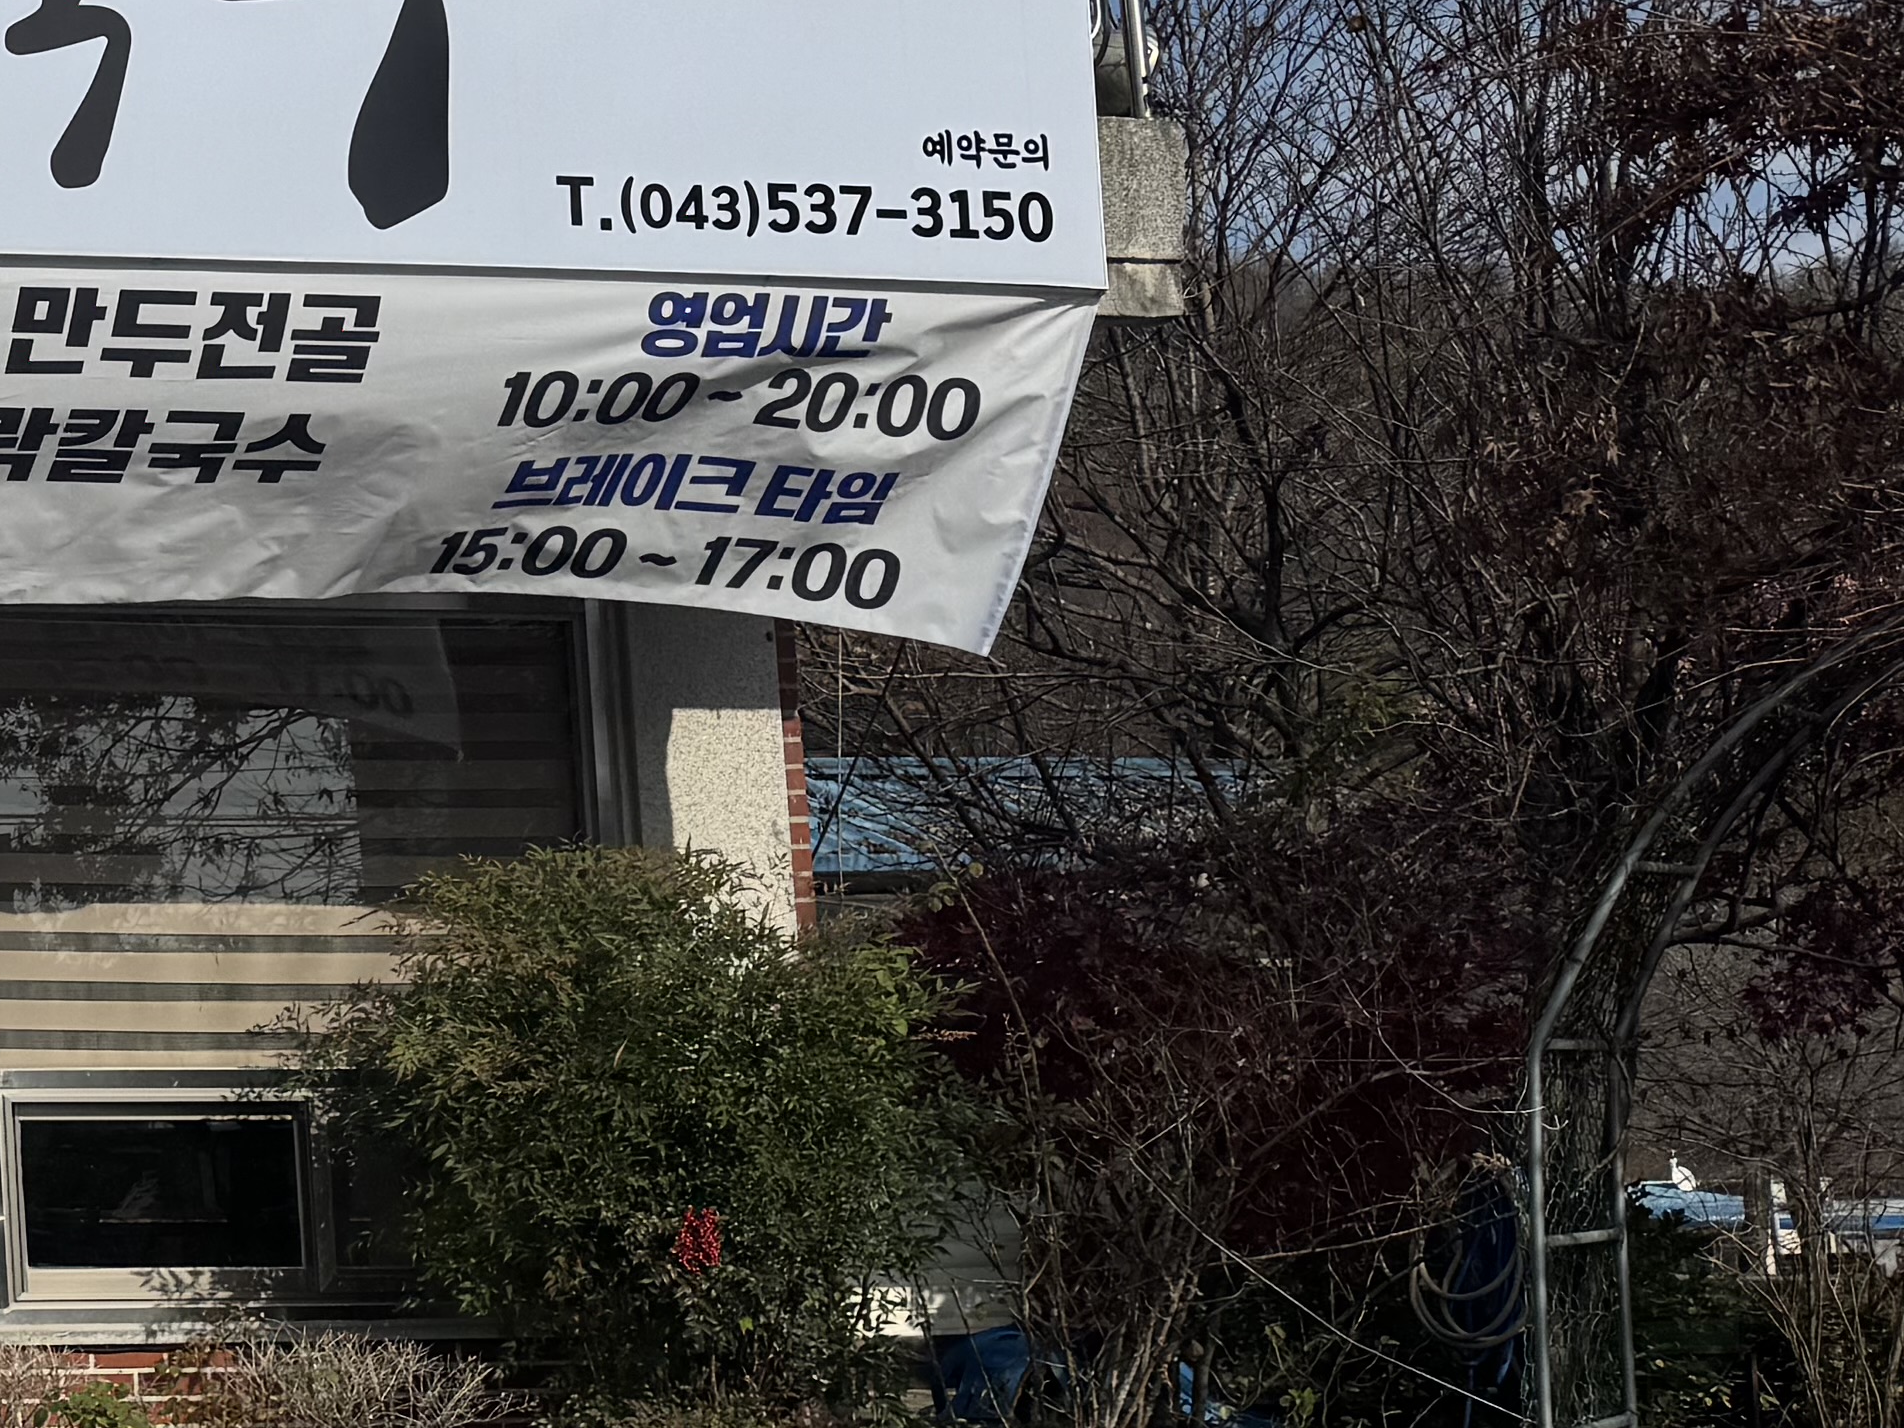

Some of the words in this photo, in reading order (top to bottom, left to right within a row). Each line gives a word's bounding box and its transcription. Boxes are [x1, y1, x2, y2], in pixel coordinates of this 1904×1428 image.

[922, 130, 1050, 171] 예약문의
[555, 175, 1054, 243] T.(043)537-3150
[2, 284, 383, 385] 만두전골
[640, 290, 892, 362] 영업시간
[497, 369, 696, 429] 10:00
[752, 369, 982, 443] 20:00
[492, 449, 758, 519] 브레이크
[761, 461, 901, 527] 타임
[429, 526, 626, 578] 15:00
[683, 535, 903, 610] 17:00
